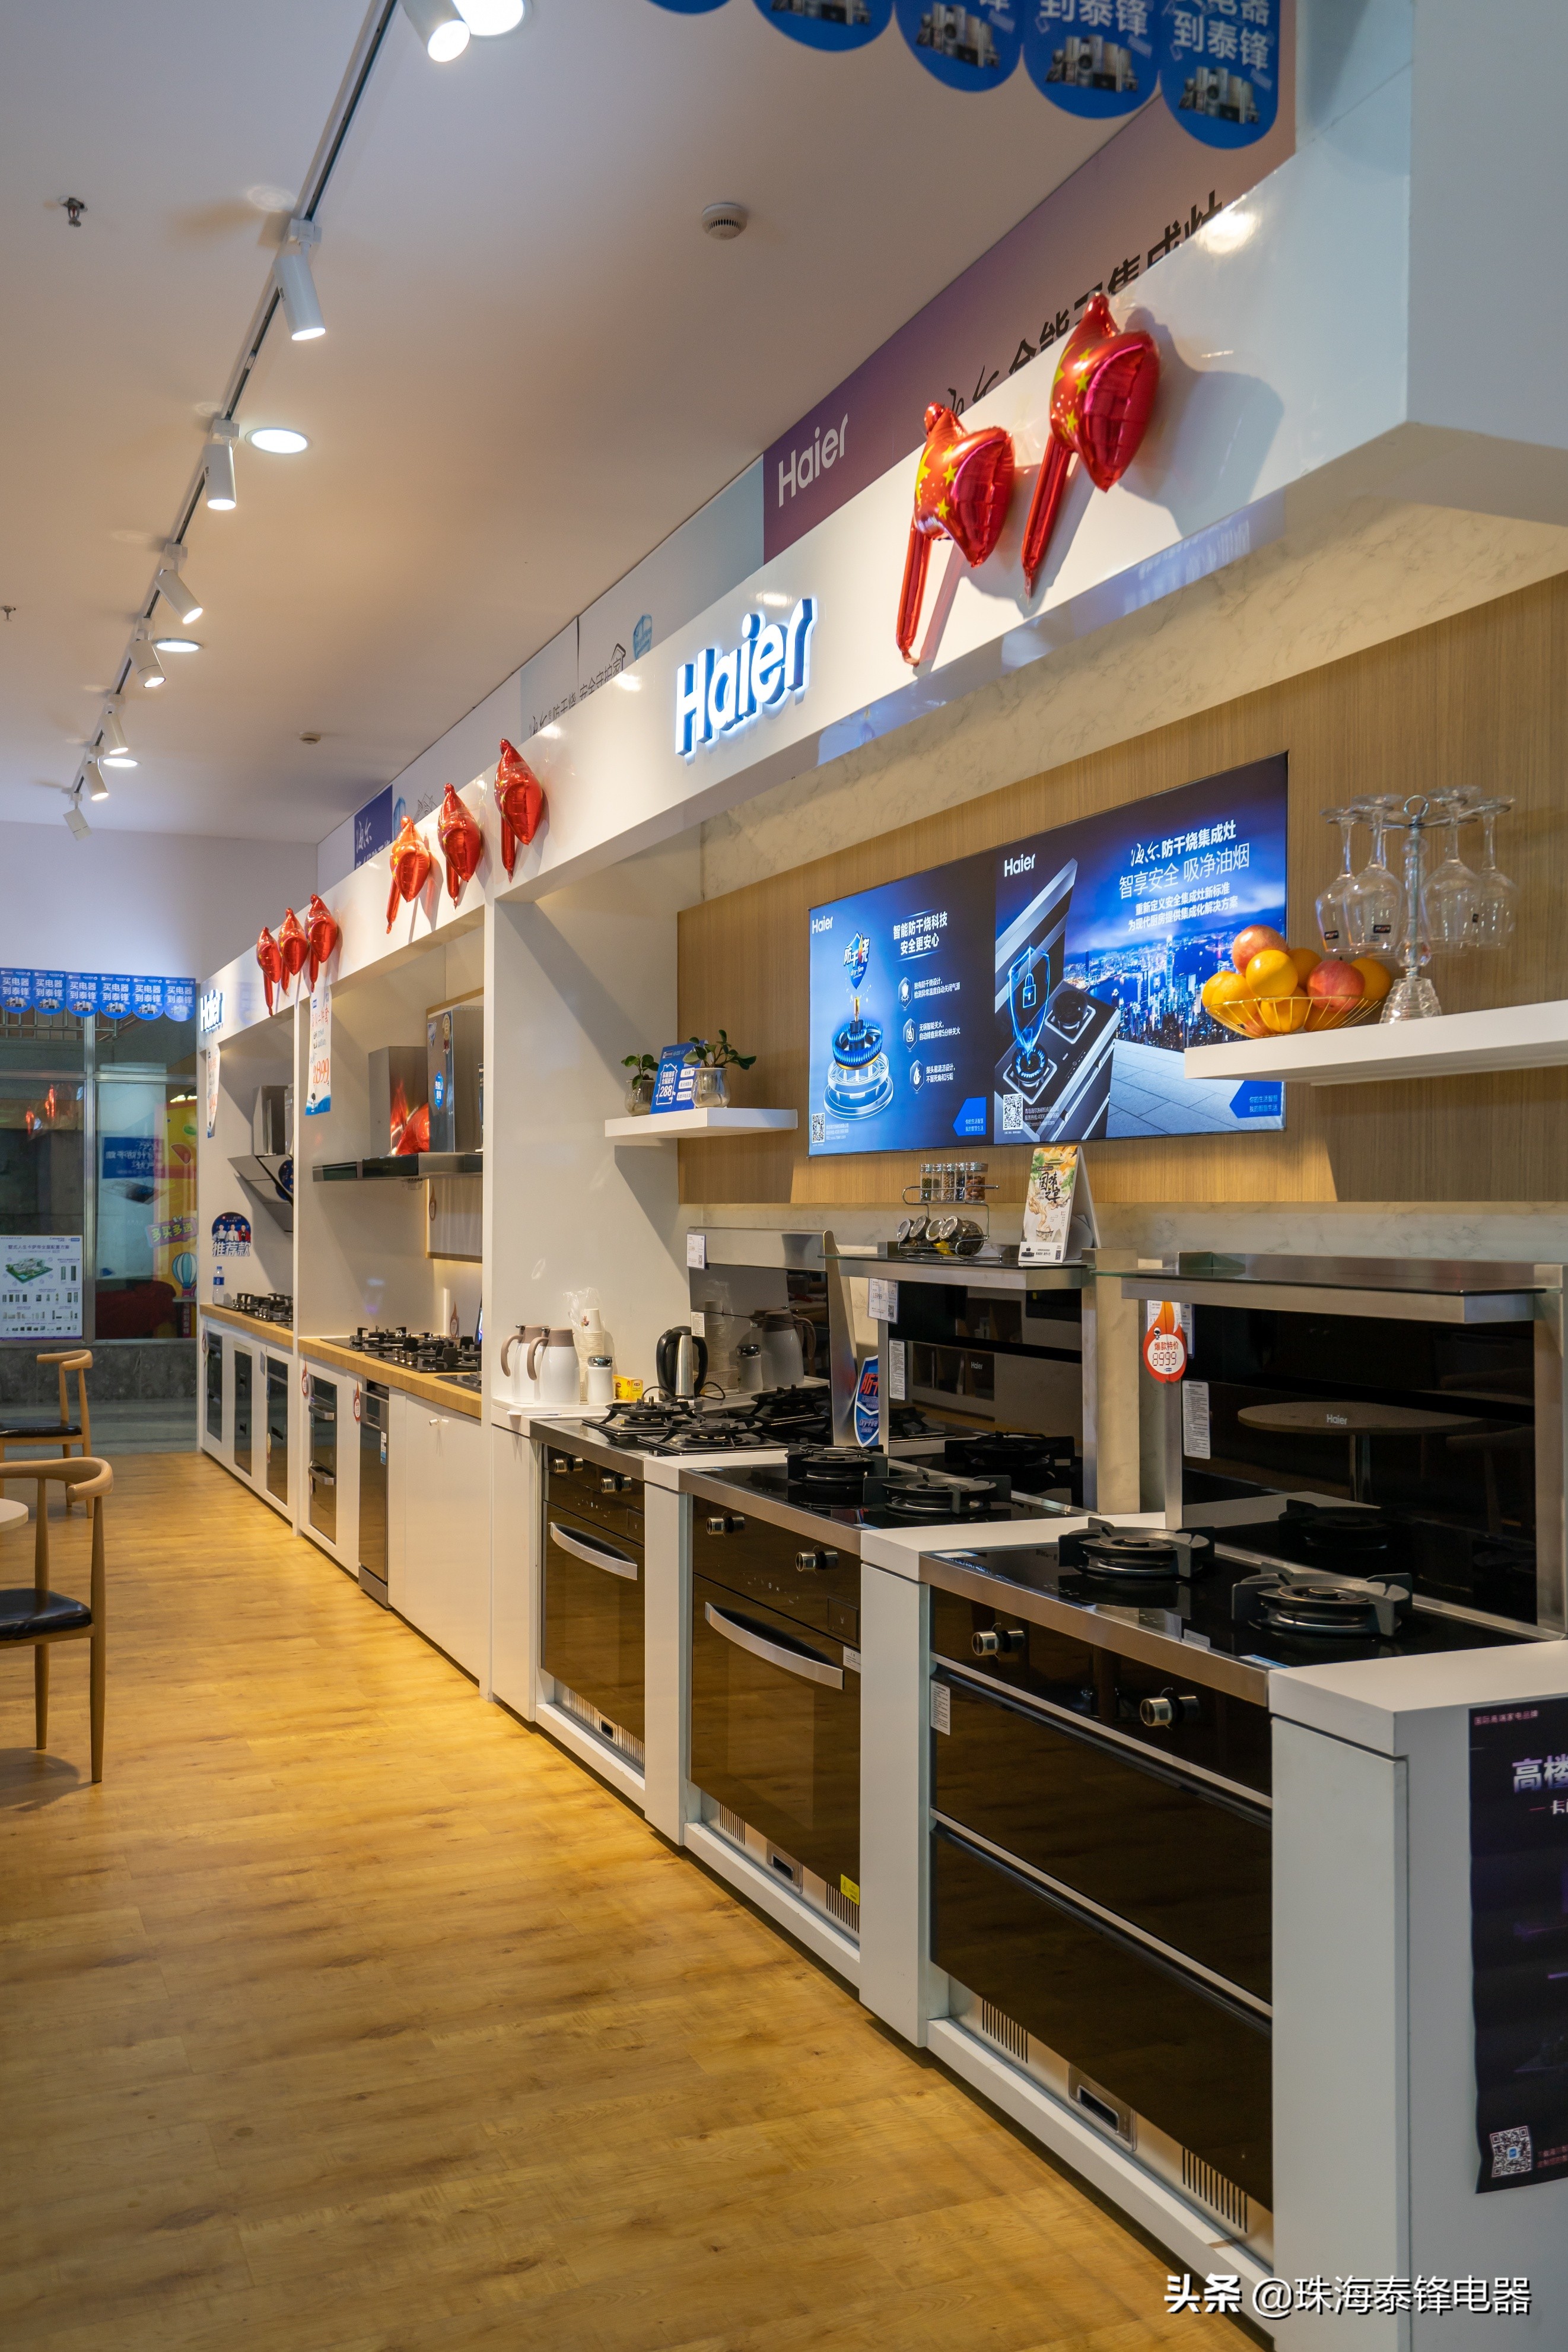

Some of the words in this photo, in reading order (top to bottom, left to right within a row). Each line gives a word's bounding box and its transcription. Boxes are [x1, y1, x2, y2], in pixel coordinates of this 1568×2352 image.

[1173, 9, 1269, 71] 到泰锋
[778, 413, 849, 508] Haier
[675, 597, 819, 757] Haier
[1004, 853, 1036, 878] Haier
[1119, 862, 1179, 900] 智享安全
[1183, 843, 1250, 883] 吸净油烟
[1135, 882, 1230, 916] 重新定义安全集成灶新标准
[1128, 895, 1239, 932] 为现代厨房提供集成化解决方案
[812, 916, 834, 935] Haier
[893, 911, 948, 940] 智能防干烧科技
[900, 932, 940, 956] 安全更安心
[2, 977, 30, 987] 买电器
[35, 978, 63, 988] 买电器
[69, 981, 97, 991] 买电器
[2, 987, 30, 996] 到泰锋
[35, 989, 63, 997] 到泰锋
[102, 983, 129, 993] 买电器
[135, 984, 161, 994] 买电器
[167, 986, 193, 995] 买电器
[69, 991, 97, 1000] 到泰锋
[102, 993, 129, 1002] 到泰锋
[134, 994, 161, 1003] 到泰锋
[167, 995, 193, 1004] 到泰锋
[659, 1085, 673, 1097] 288
[212, 1241, 251, 1257] 推荐款
[1154, 1341, 1179, 1351] 爆款特价
[1152, 1351, 1177, 1366] 8999
[971, 1361, 983, 1369] Haier
[1326, 1413, 1348, 1425] Haier
